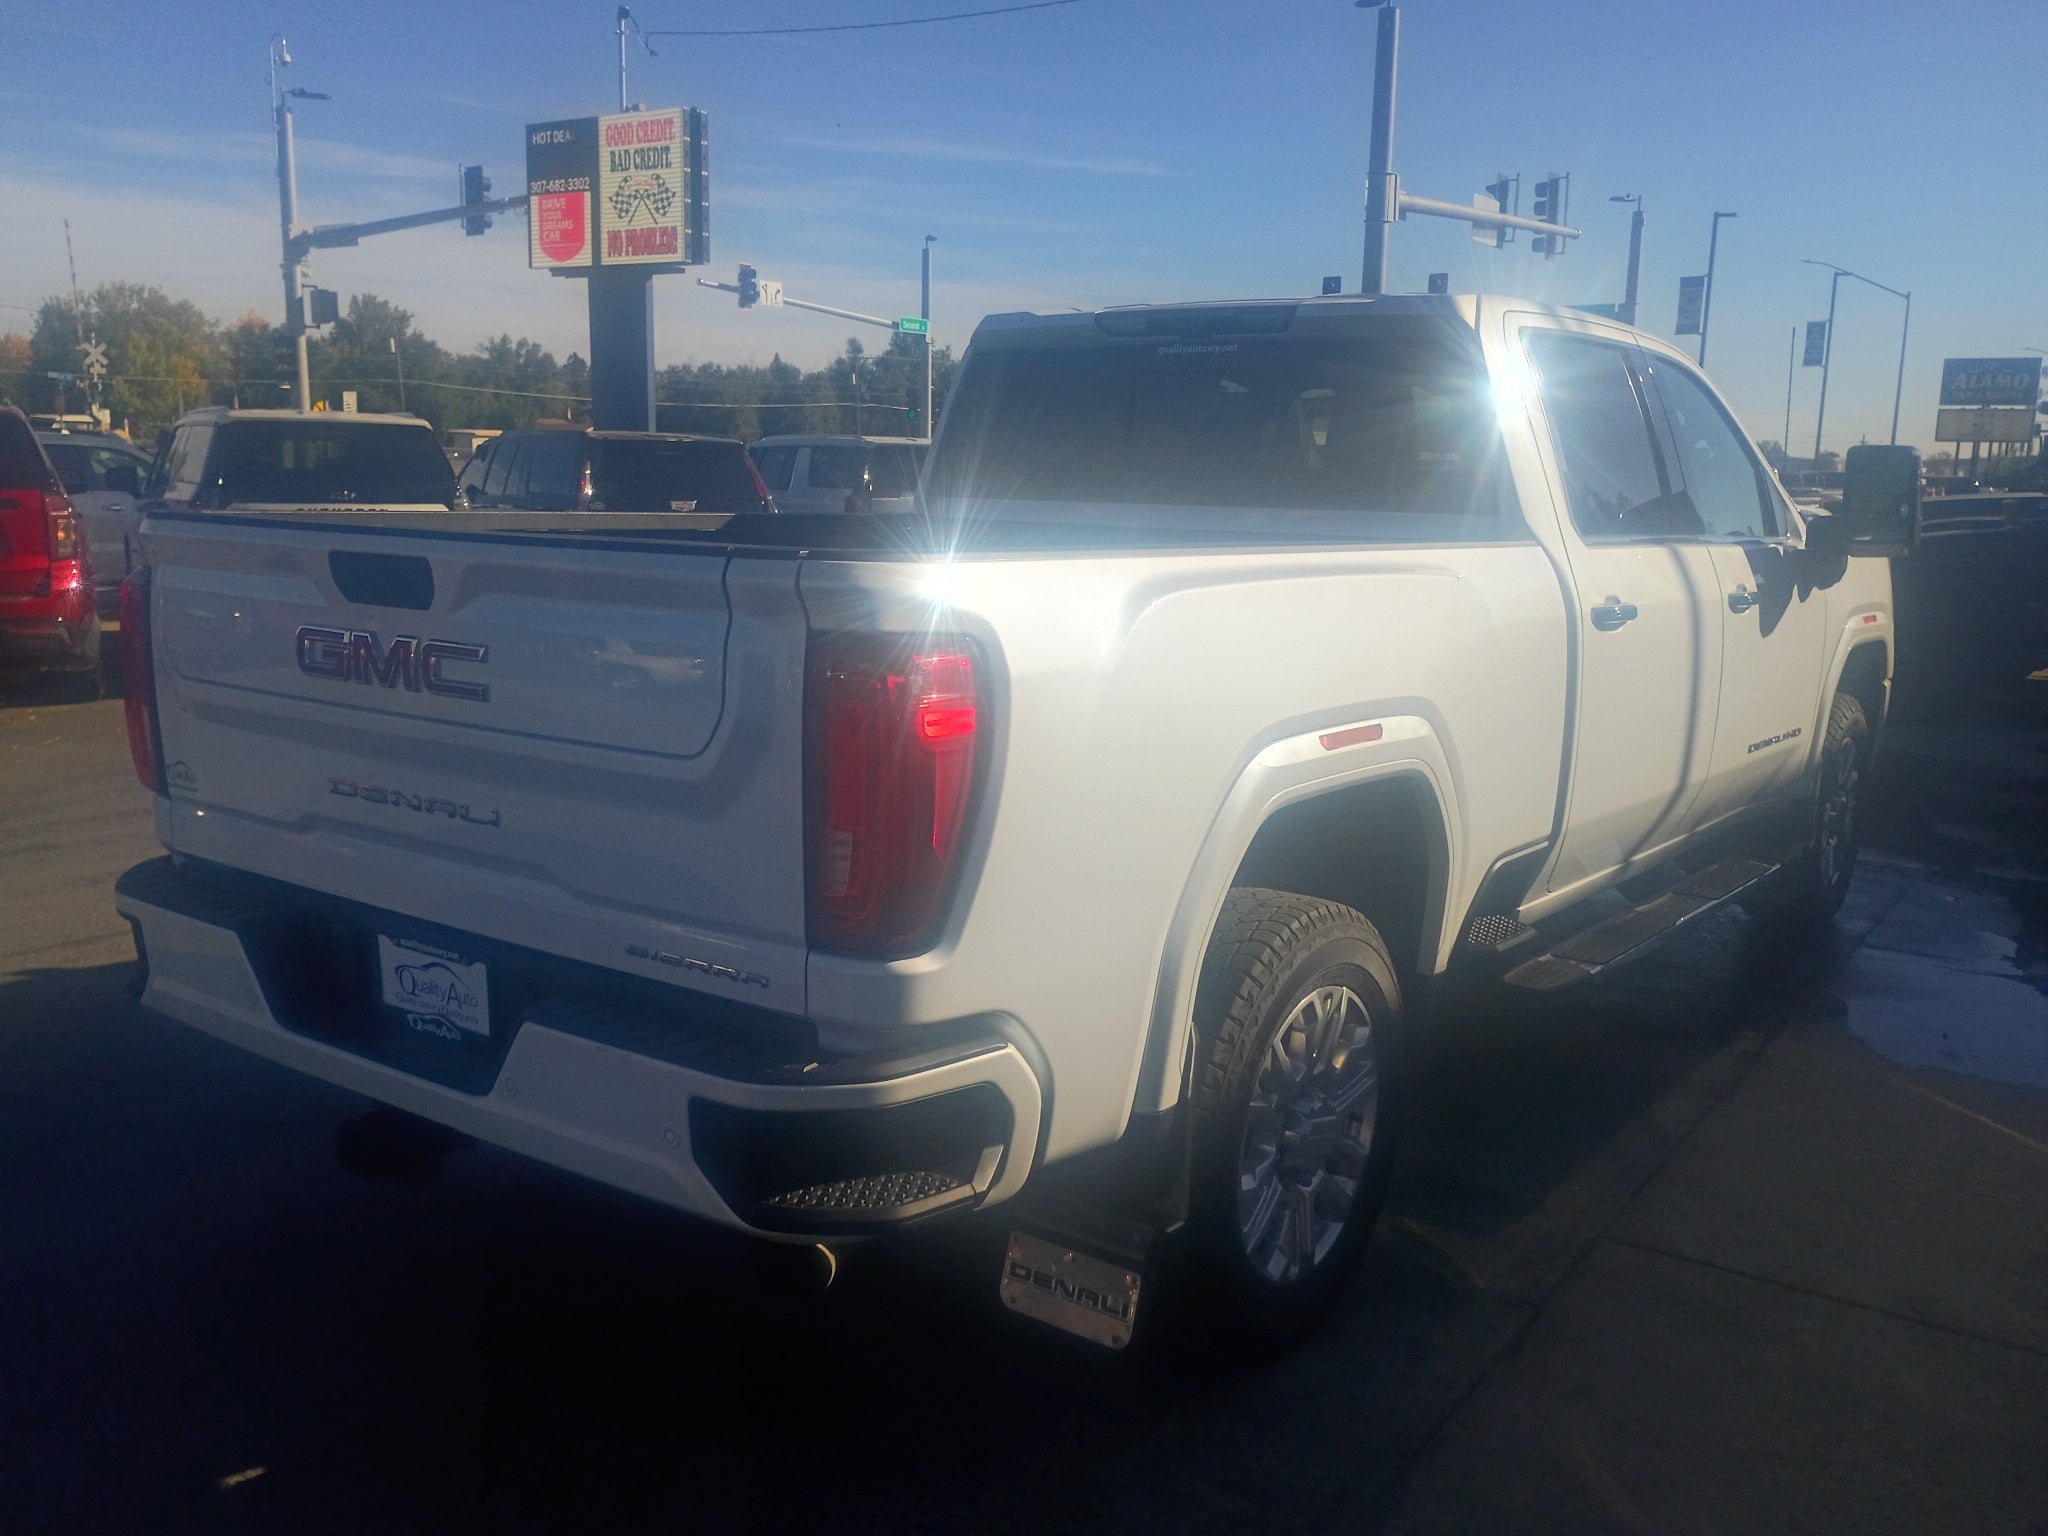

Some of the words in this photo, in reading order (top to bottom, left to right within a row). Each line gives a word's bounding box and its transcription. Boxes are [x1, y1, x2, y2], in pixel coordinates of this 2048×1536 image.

[532, 131, 552, 146] HOT
[553, 128, 573, 143] DEA
[605, 121, 634, 147] GOOD
[610, 149, 631, 172] BAD
[530, 177, 590, 194] 307-682-3302
[542, 197, 567, 210] DRIVE
[542, 209, 562, 220] YOUR
[542, 219, 573, 231] DREAMS
[542, 230, 561, 242] CAR
[607, 229, 624, 257] NO
[1951, 372, 2030, 389] ALAMO
[295, 624, 490, 703] GMC
[327, 775, 501, 828] DENALI
[624, 943, 770, 988] SIERRA
[398, 967, 447, 1003] Quality
[446, 981, 479, 1010] Auto
[1008, 1258, 1130, 1323] DENALI
